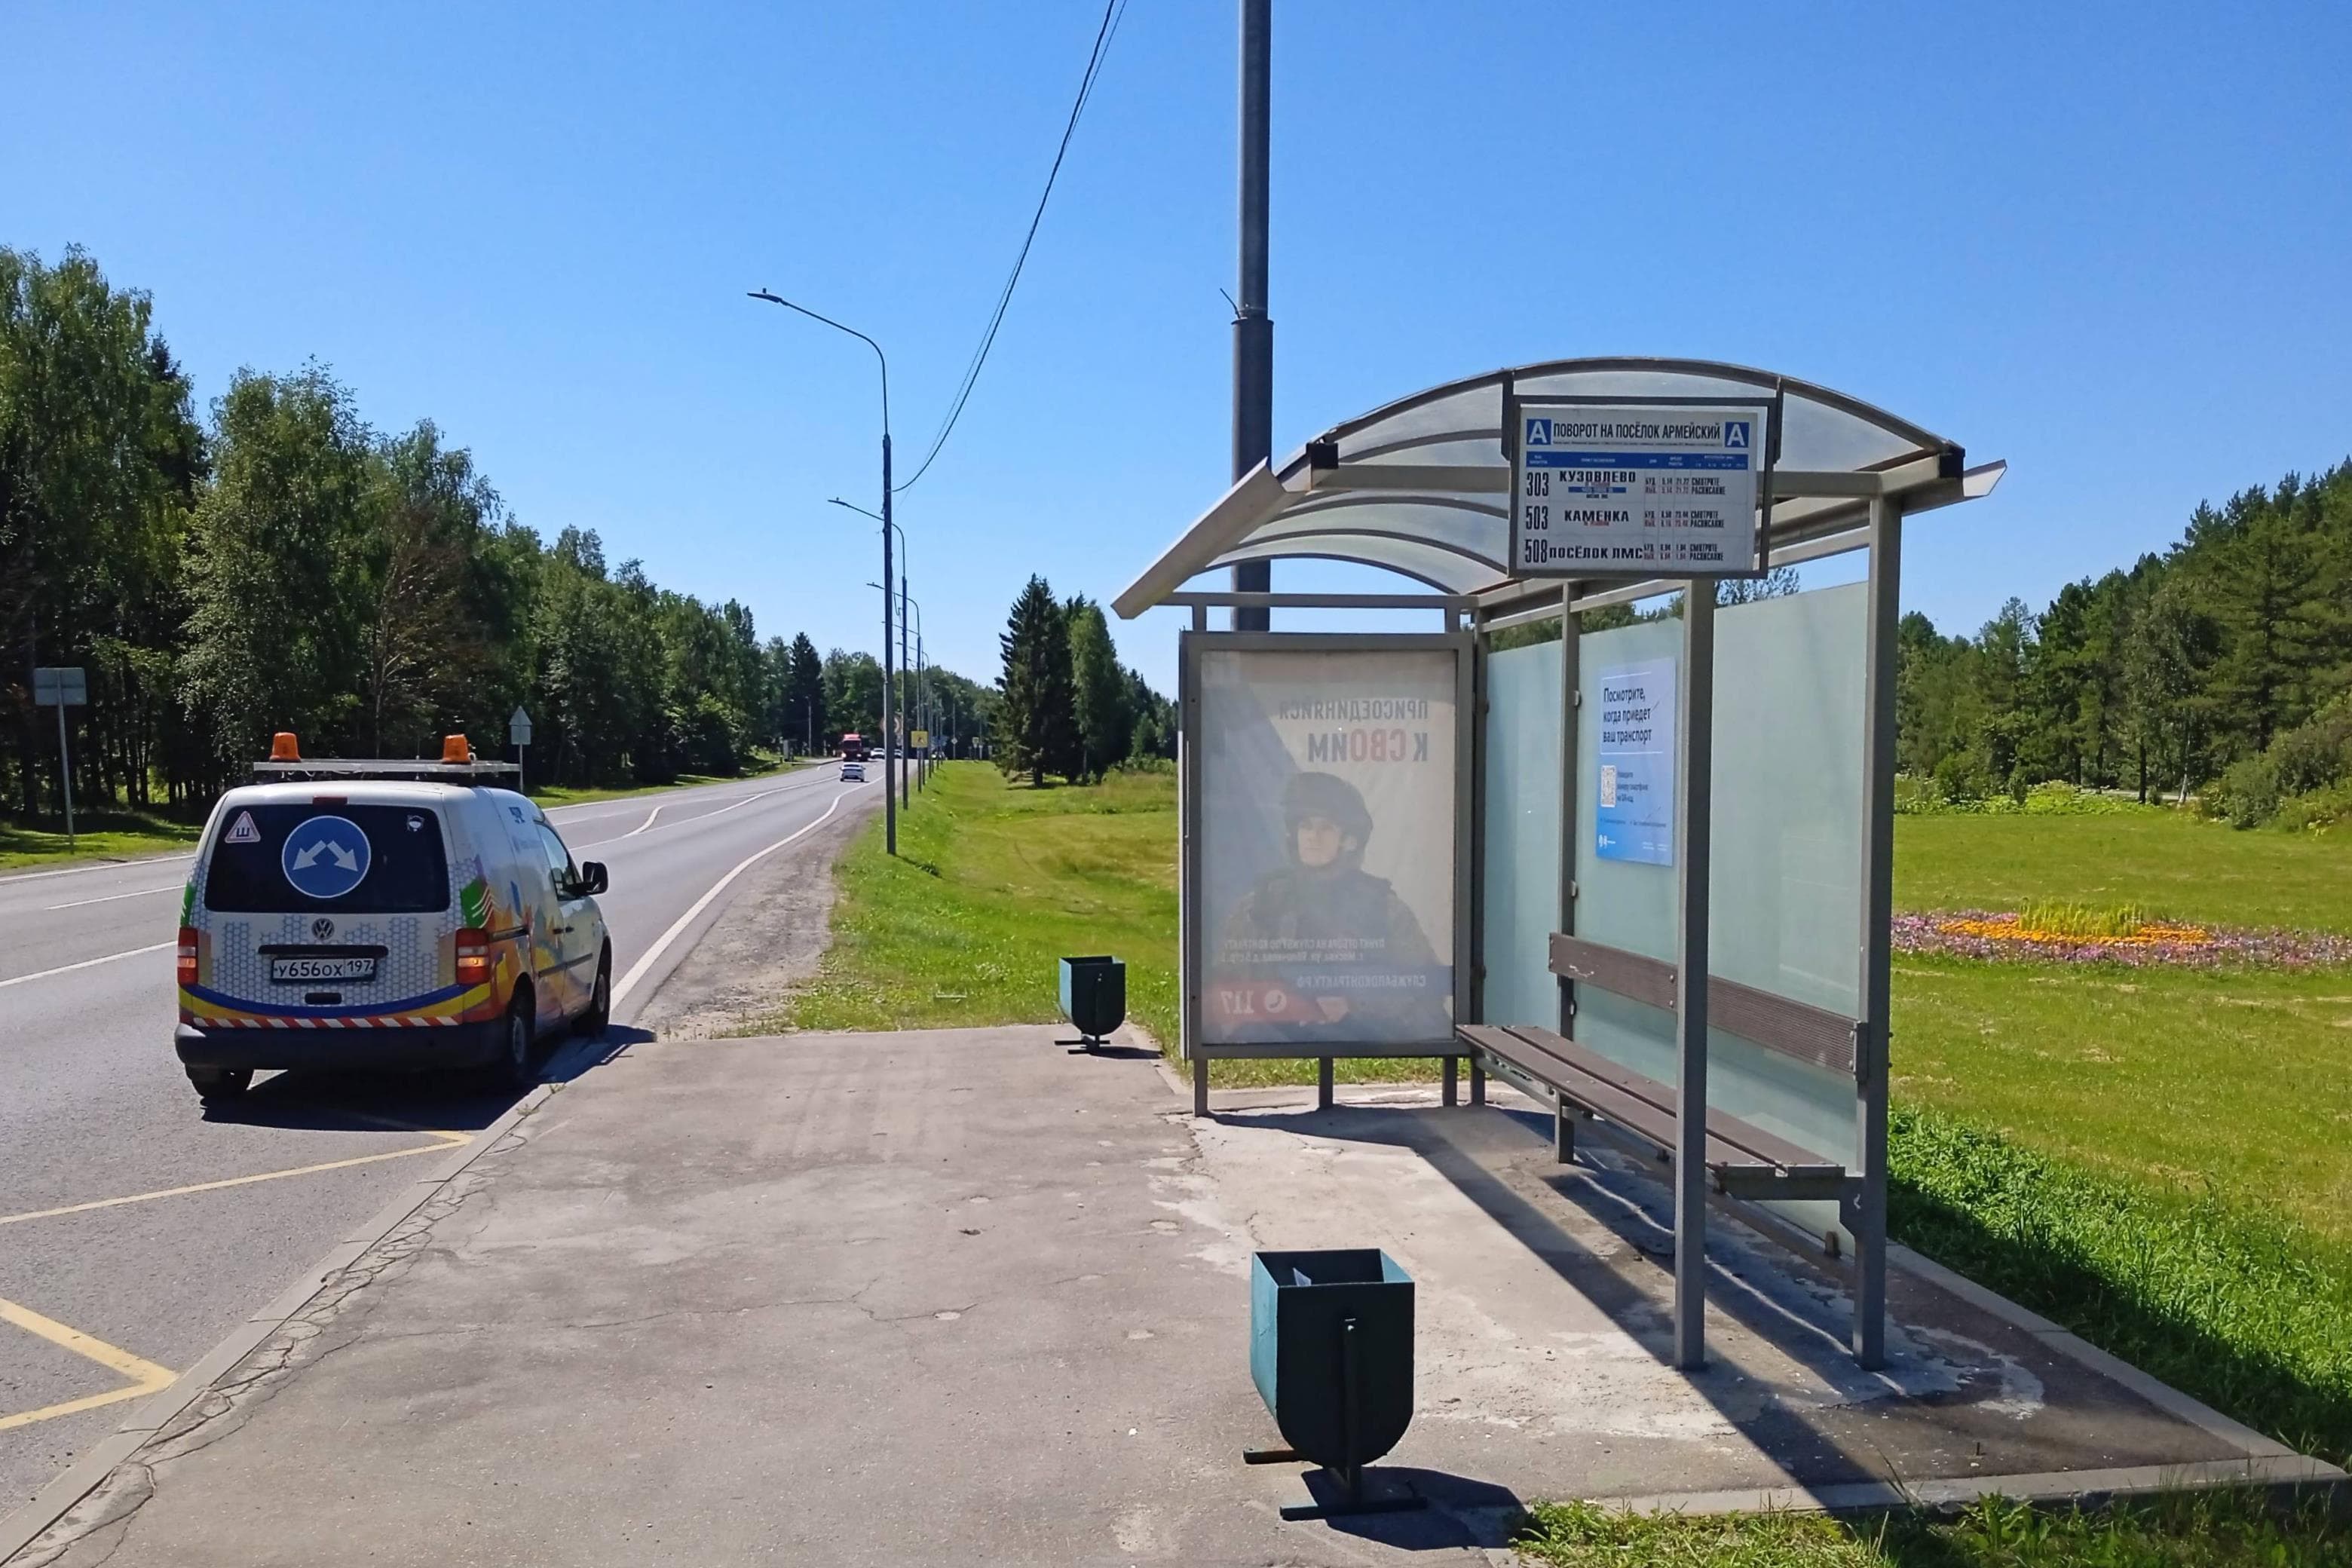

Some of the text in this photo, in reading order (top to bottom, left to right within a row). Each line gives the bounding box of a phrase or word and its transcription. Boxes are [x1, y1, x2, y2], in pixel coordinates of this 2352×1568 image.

[1554, 421, 1720, 439] ПОВОРОТ НА ПОСЁЛОК АРМЕЙСКИЙ
[1559, 470, 1636, 483] КУЗОВЛЕВО
[1691, 477, 1720, 485] СМОТРИТЕ
[1527, 472, 1549, 497] 303
[1691, 486, 1726, 495] РАСПИСАНИЕ
[1526, 506, 1548, 530] 503
[1564, 510, 1629, 522] КАМЕНКА
[1690, 519, 1724, 528] РАСПИСАНИЕ
[1525, 539, 1548, 563] 508
[1549, 545, 1643, 559] ПОСЁЛОК ЛМС
[1603, 687, 1646, 704] Посмотрите,
[1603, 709, 1651, 725] когда приедет
[1603, 729, 1652, 746] ваш транспорт
[236, 827, 250, 838] Ш
